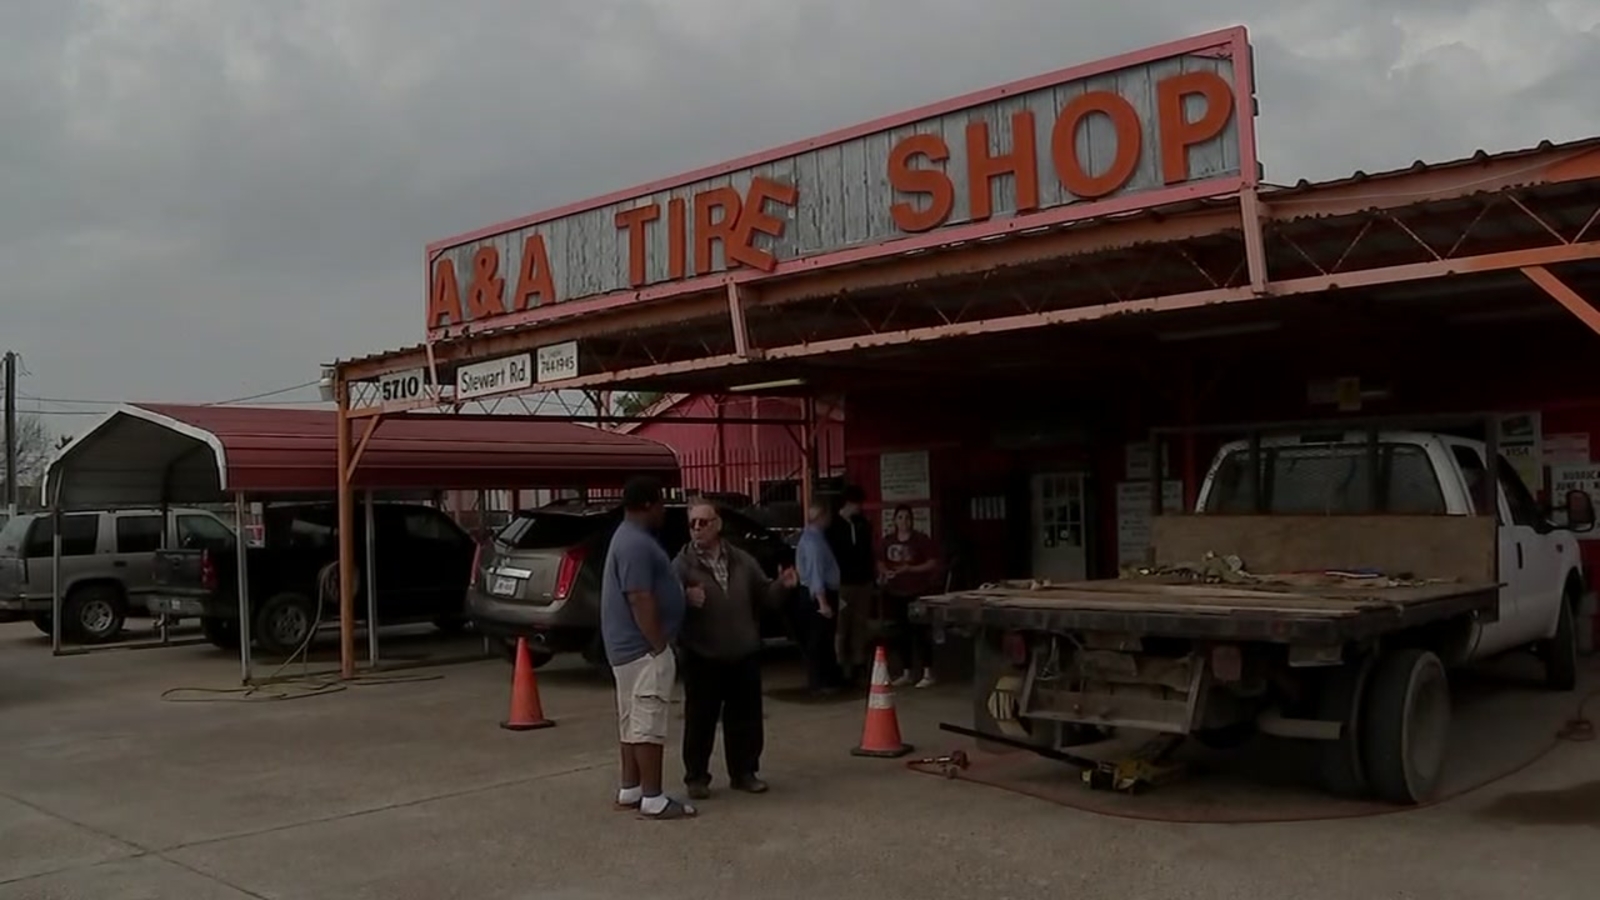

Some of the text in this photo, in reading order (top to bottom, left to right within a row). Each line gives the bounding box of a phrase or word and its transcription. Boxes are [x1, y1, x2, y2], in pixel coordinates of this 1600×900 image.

[428, 71, 1235, 328] A&A TIRE SHOP
[382, 376, 418, 400] 5710
[461, 369, 506, 393] Stewart
